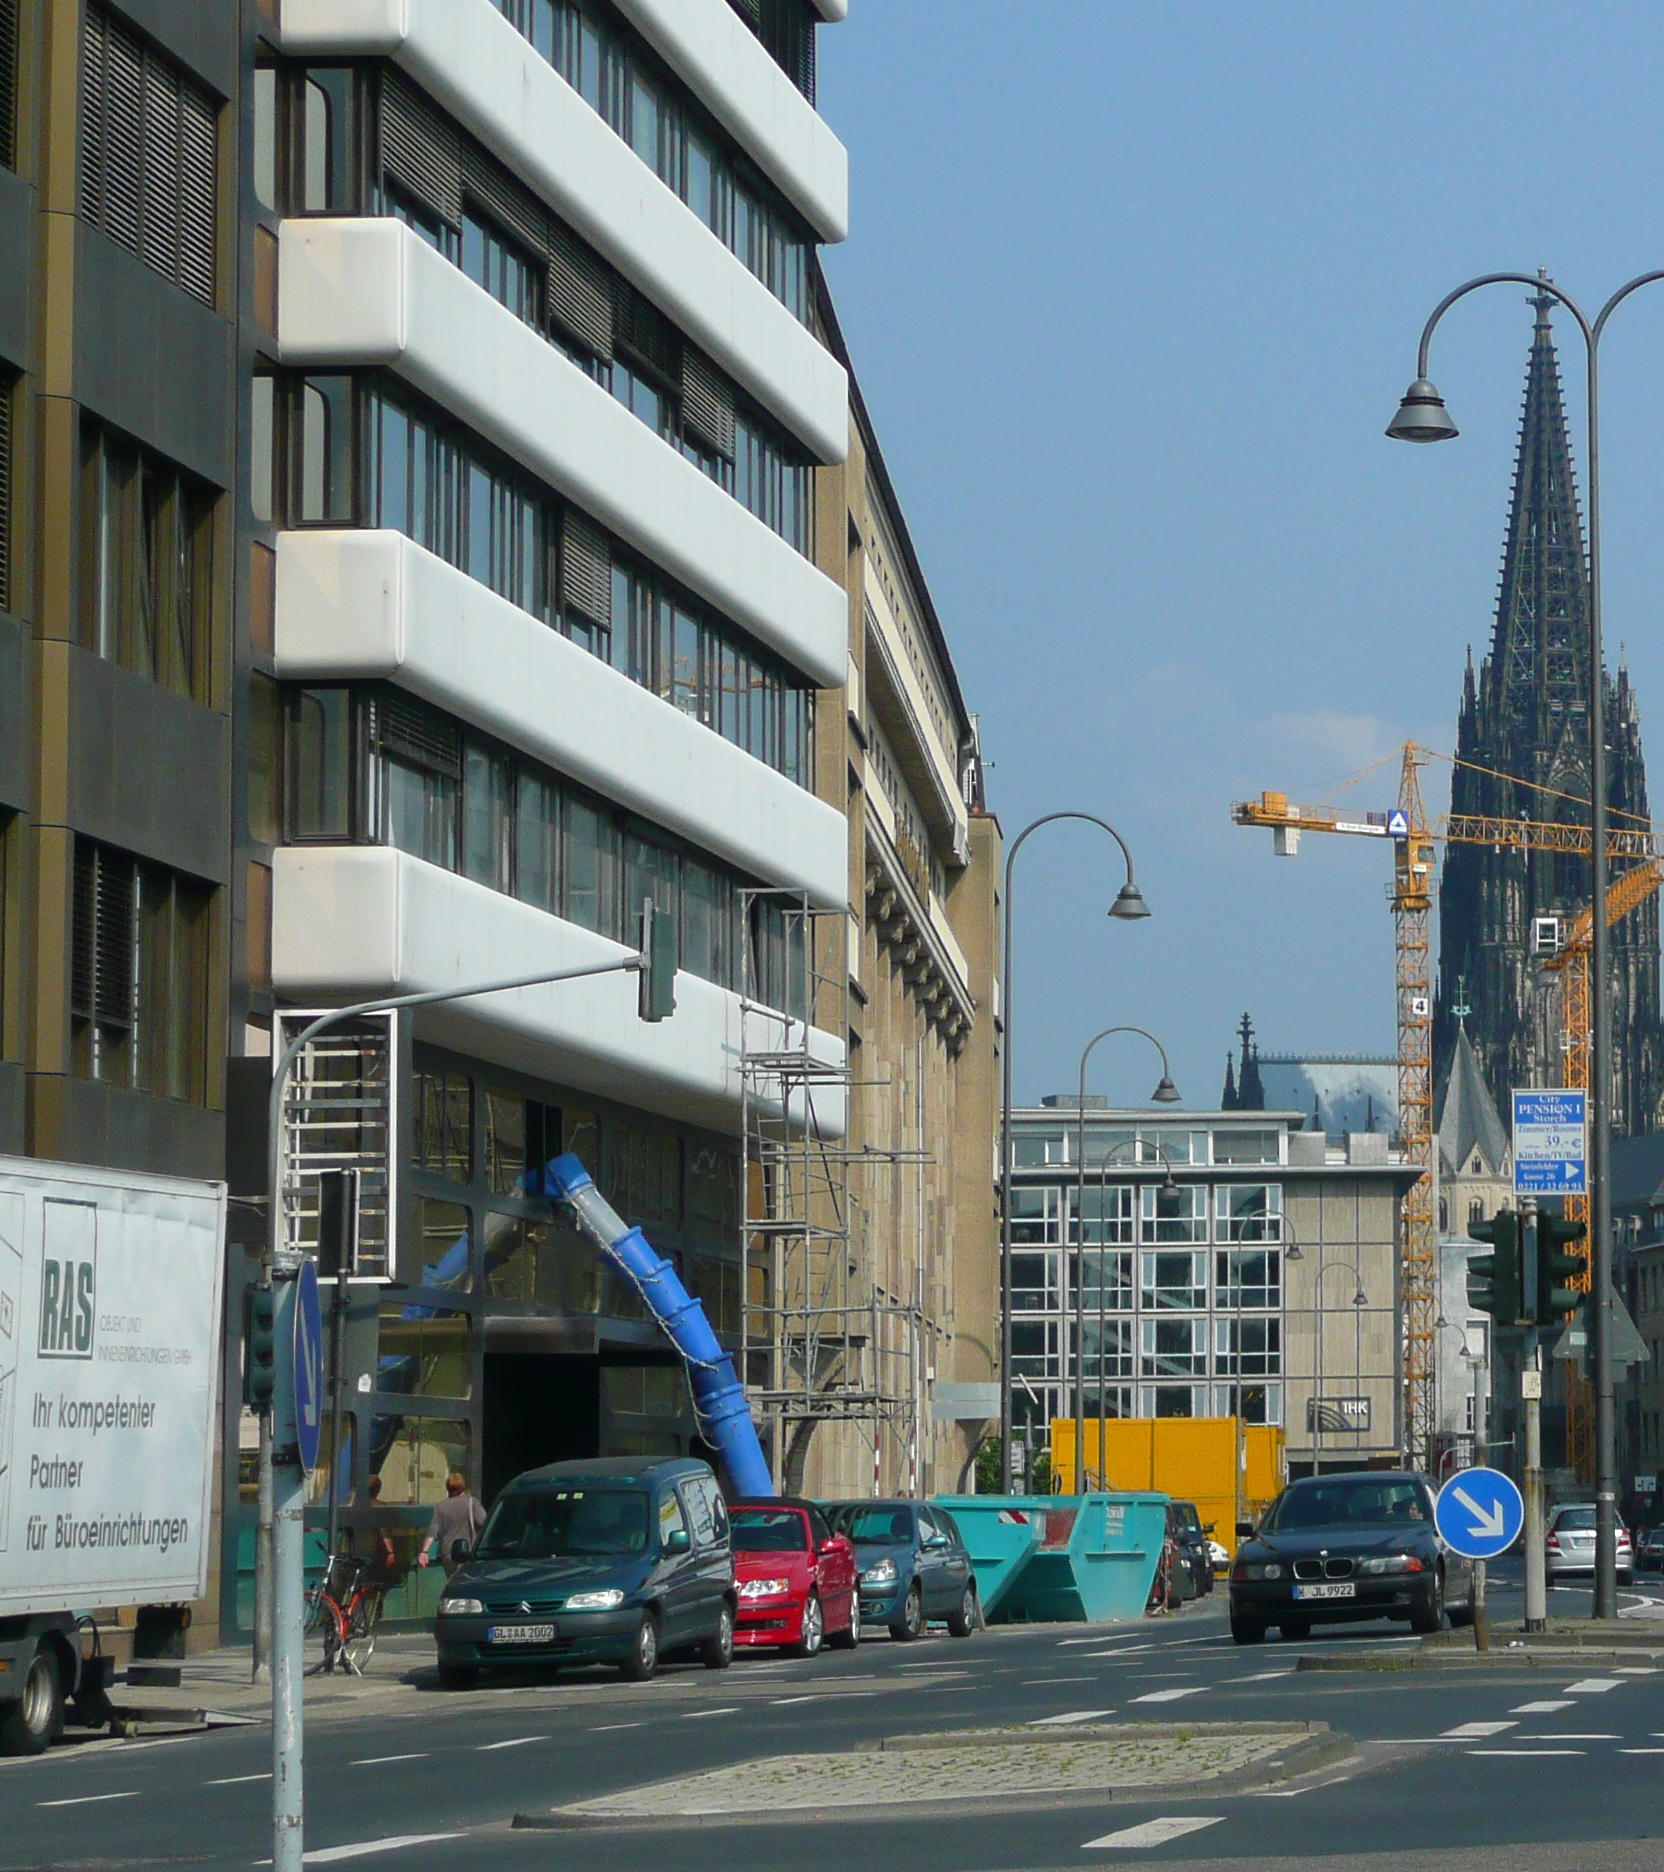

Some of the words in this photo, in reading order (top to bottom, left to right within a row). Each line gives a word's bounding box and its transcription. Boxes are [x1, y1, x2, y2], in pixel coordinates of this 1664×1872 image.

[1416, 1000, 1425, 1012] 4
[1539, 1095, 1561, 1104] City
[1519, 1104, 1573, 1114] PENSION
[41, 1258, 93, 1352] RAS
[33, 1392, 53, 1428] Ihr
[58, 1393, 156, 1436] kompetenter
[1344, 1401, 1368, 1414] IHK
[30, 1453, 83, 1489] Partner
[26, 1514, 47, 1551] für
[55, 1512, 188, 1554] Büroeinrichtungen
[494, 1628, 507, 1639] GL
[513, 1627, 526, 1638] AA
[528, 1626, 553, 1638] 2002
